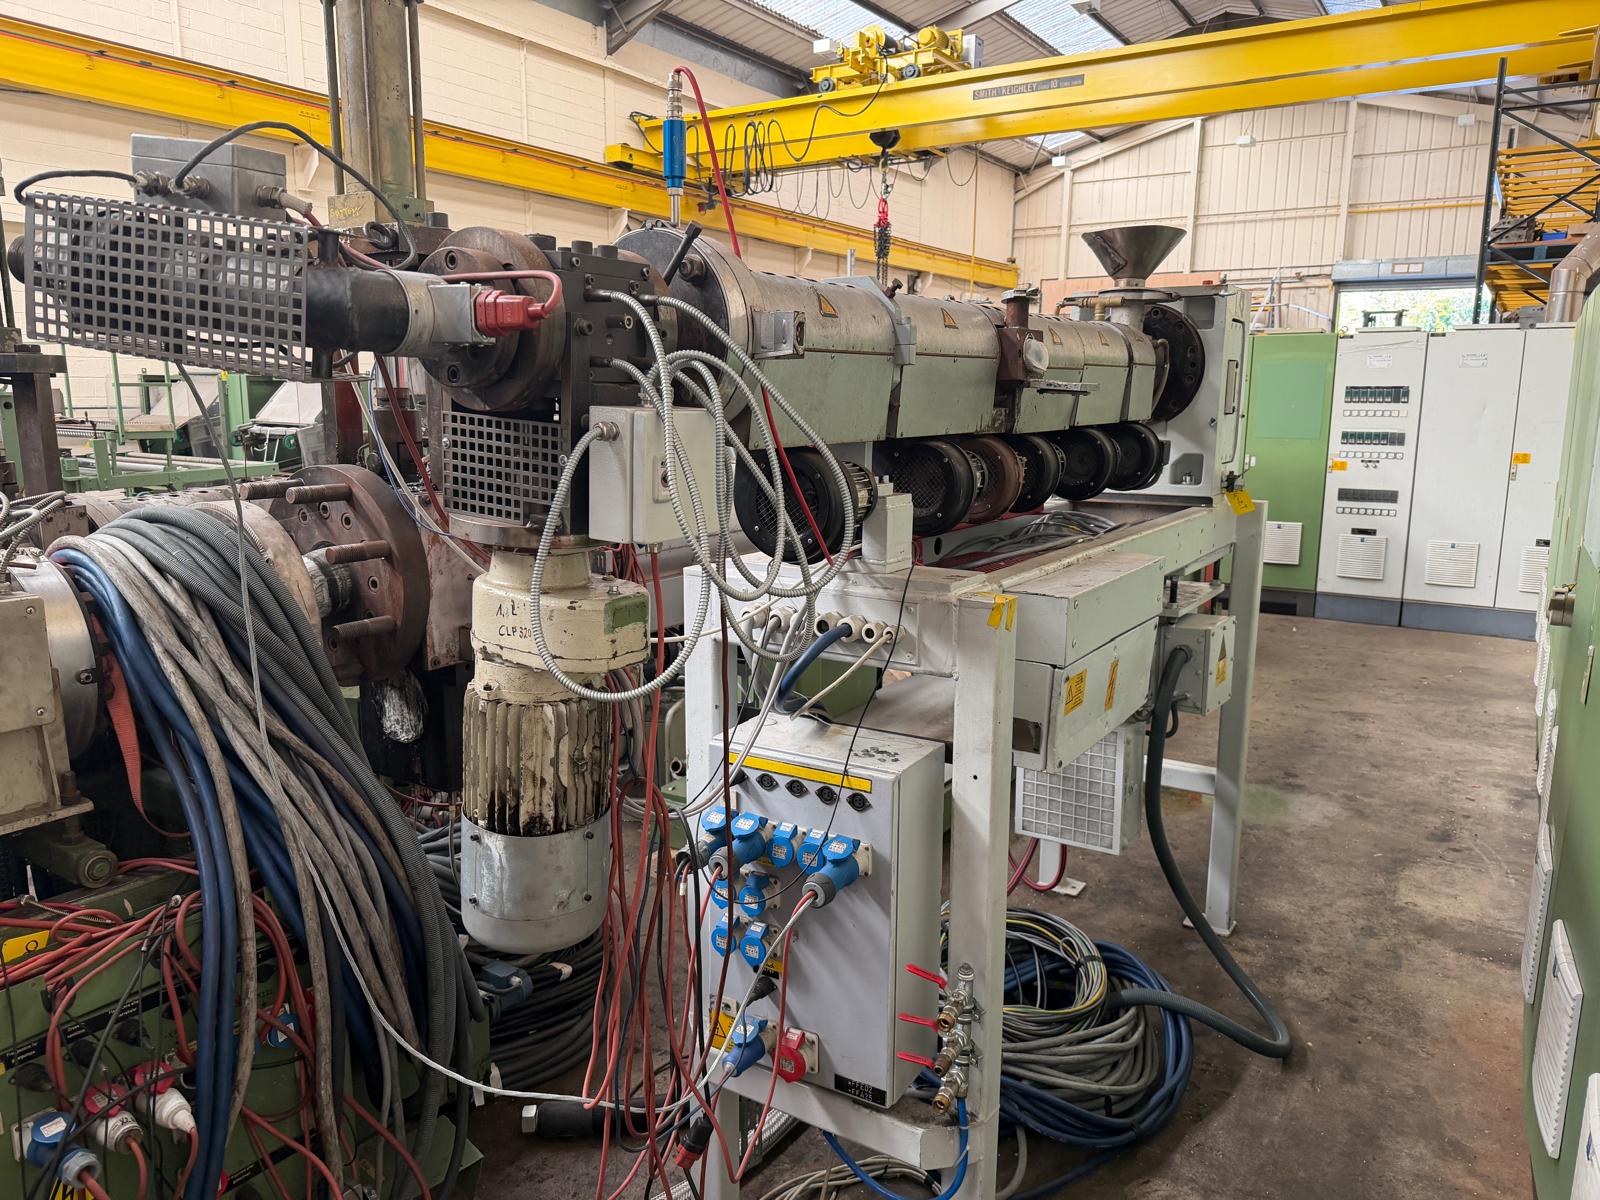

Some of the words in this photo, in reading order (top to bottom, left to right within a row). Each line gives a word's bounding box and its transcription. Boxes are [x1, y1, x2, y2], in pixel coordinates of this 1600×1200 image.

[974, 88, 998, 100] SMITH
[1001, 82, 1038, 96] KEIGHLEY
[498, 624, 518, 637] CLP
[519, 626, 532, 639] 320
